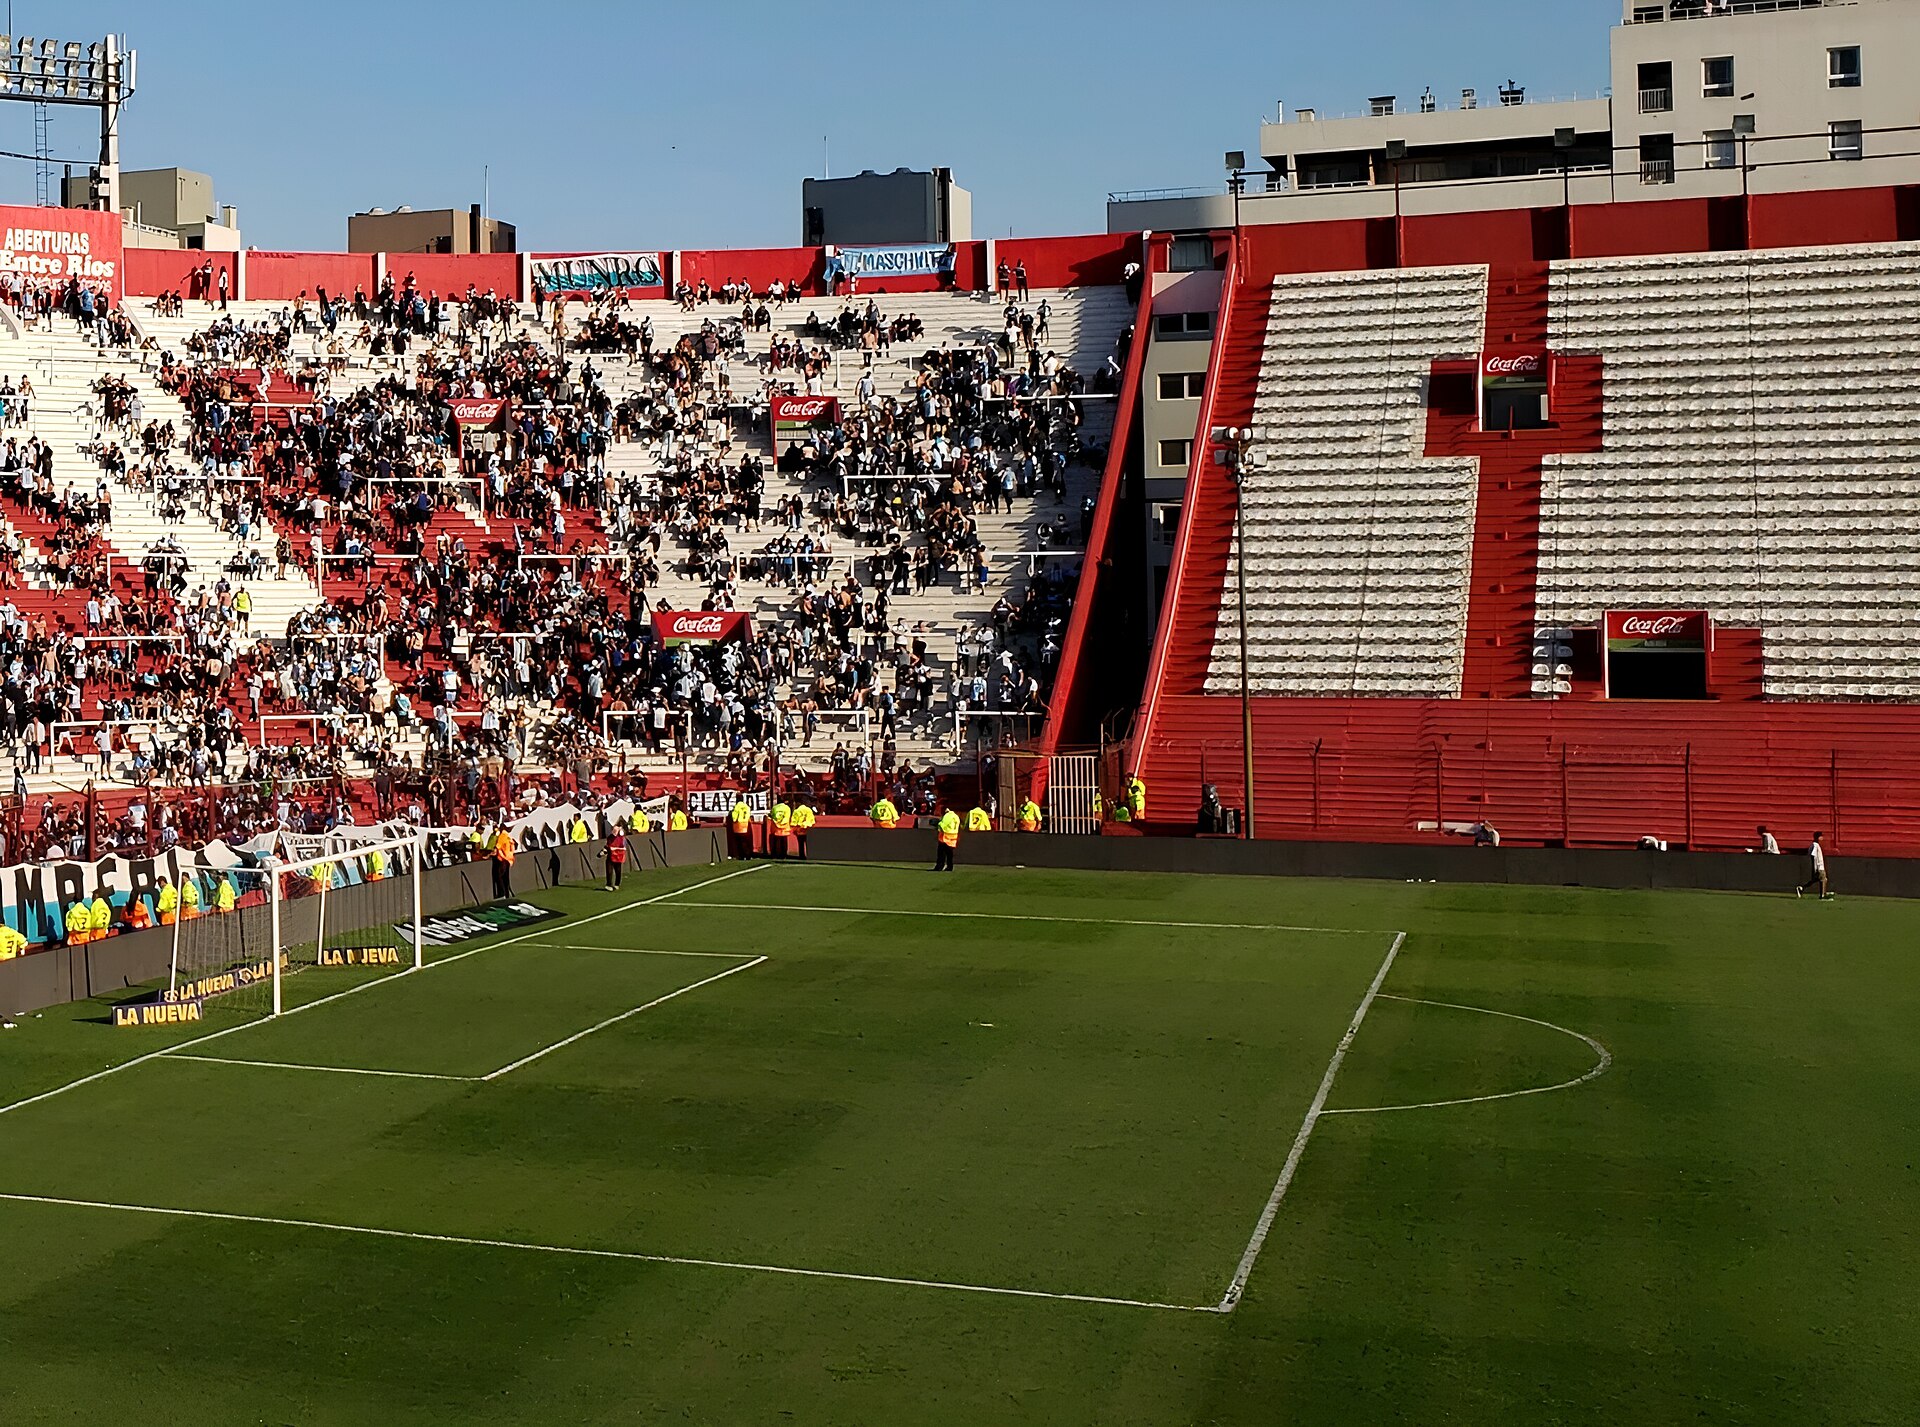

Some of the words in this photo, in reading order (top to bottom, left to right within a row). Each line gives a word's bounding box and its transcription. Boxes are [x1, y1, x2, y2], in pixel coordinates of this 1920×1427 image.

[4, 228, 90, 255] ABERTURAS
[0, 249, 62, 275] Entre
[323, 949, 344, 965] LA
[180, 983, 195, 1001] LA
[197, 973, 235, 996] NUEVA
[116, 1007, 139, 1026] LA
[142, 1002, 200, 1024] NUEVA
